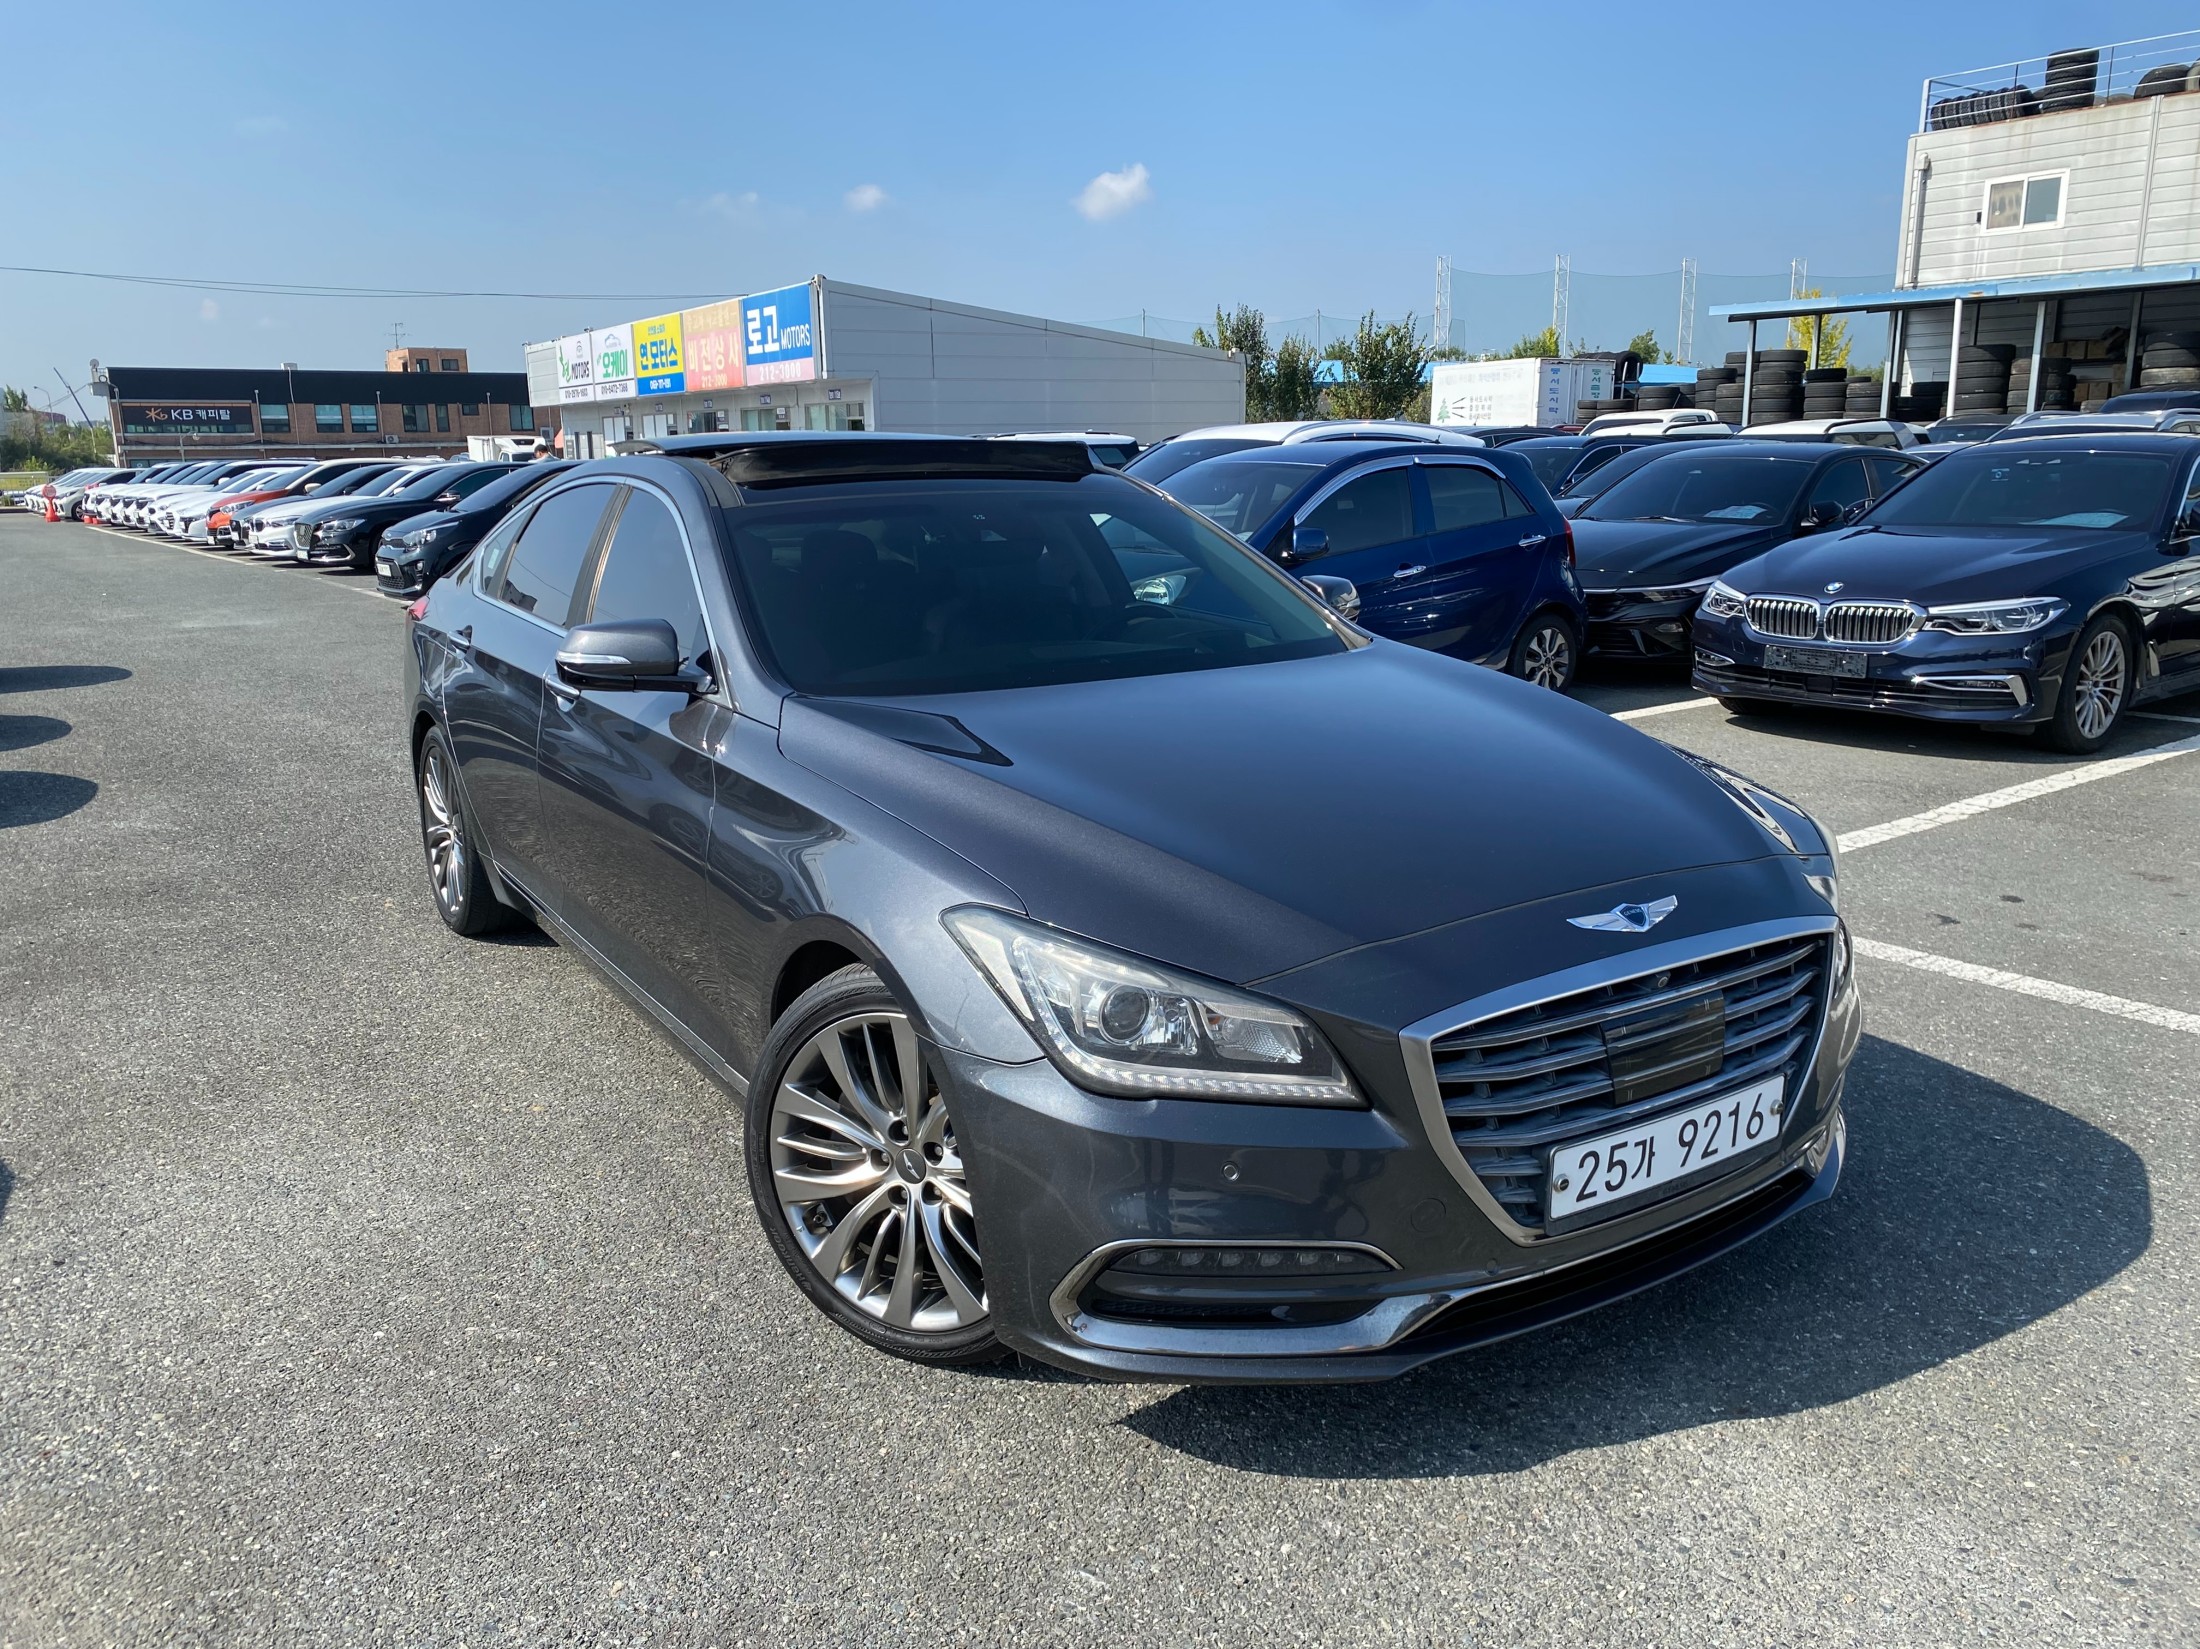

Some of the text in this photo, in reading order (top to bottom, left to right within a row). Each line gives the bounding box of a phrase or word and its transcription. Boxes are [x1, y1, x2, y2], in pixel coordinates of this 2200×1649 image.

[746, 305, 780, 355] 로고
[780, 323, 811, 350] MOTORS
[602, 348, 629, 379] 오케이
[640, 337, 679, 371] 연 모터스
[687, 331, 739, 373] 비전상사
[571, 360, 590, 381] MOTORS
[759, 361, 801, 382] 212-3000
[170, 408, 231, 421] KB 캐피탈
[1575, 1092, 1764, 1203] 25가 9216
